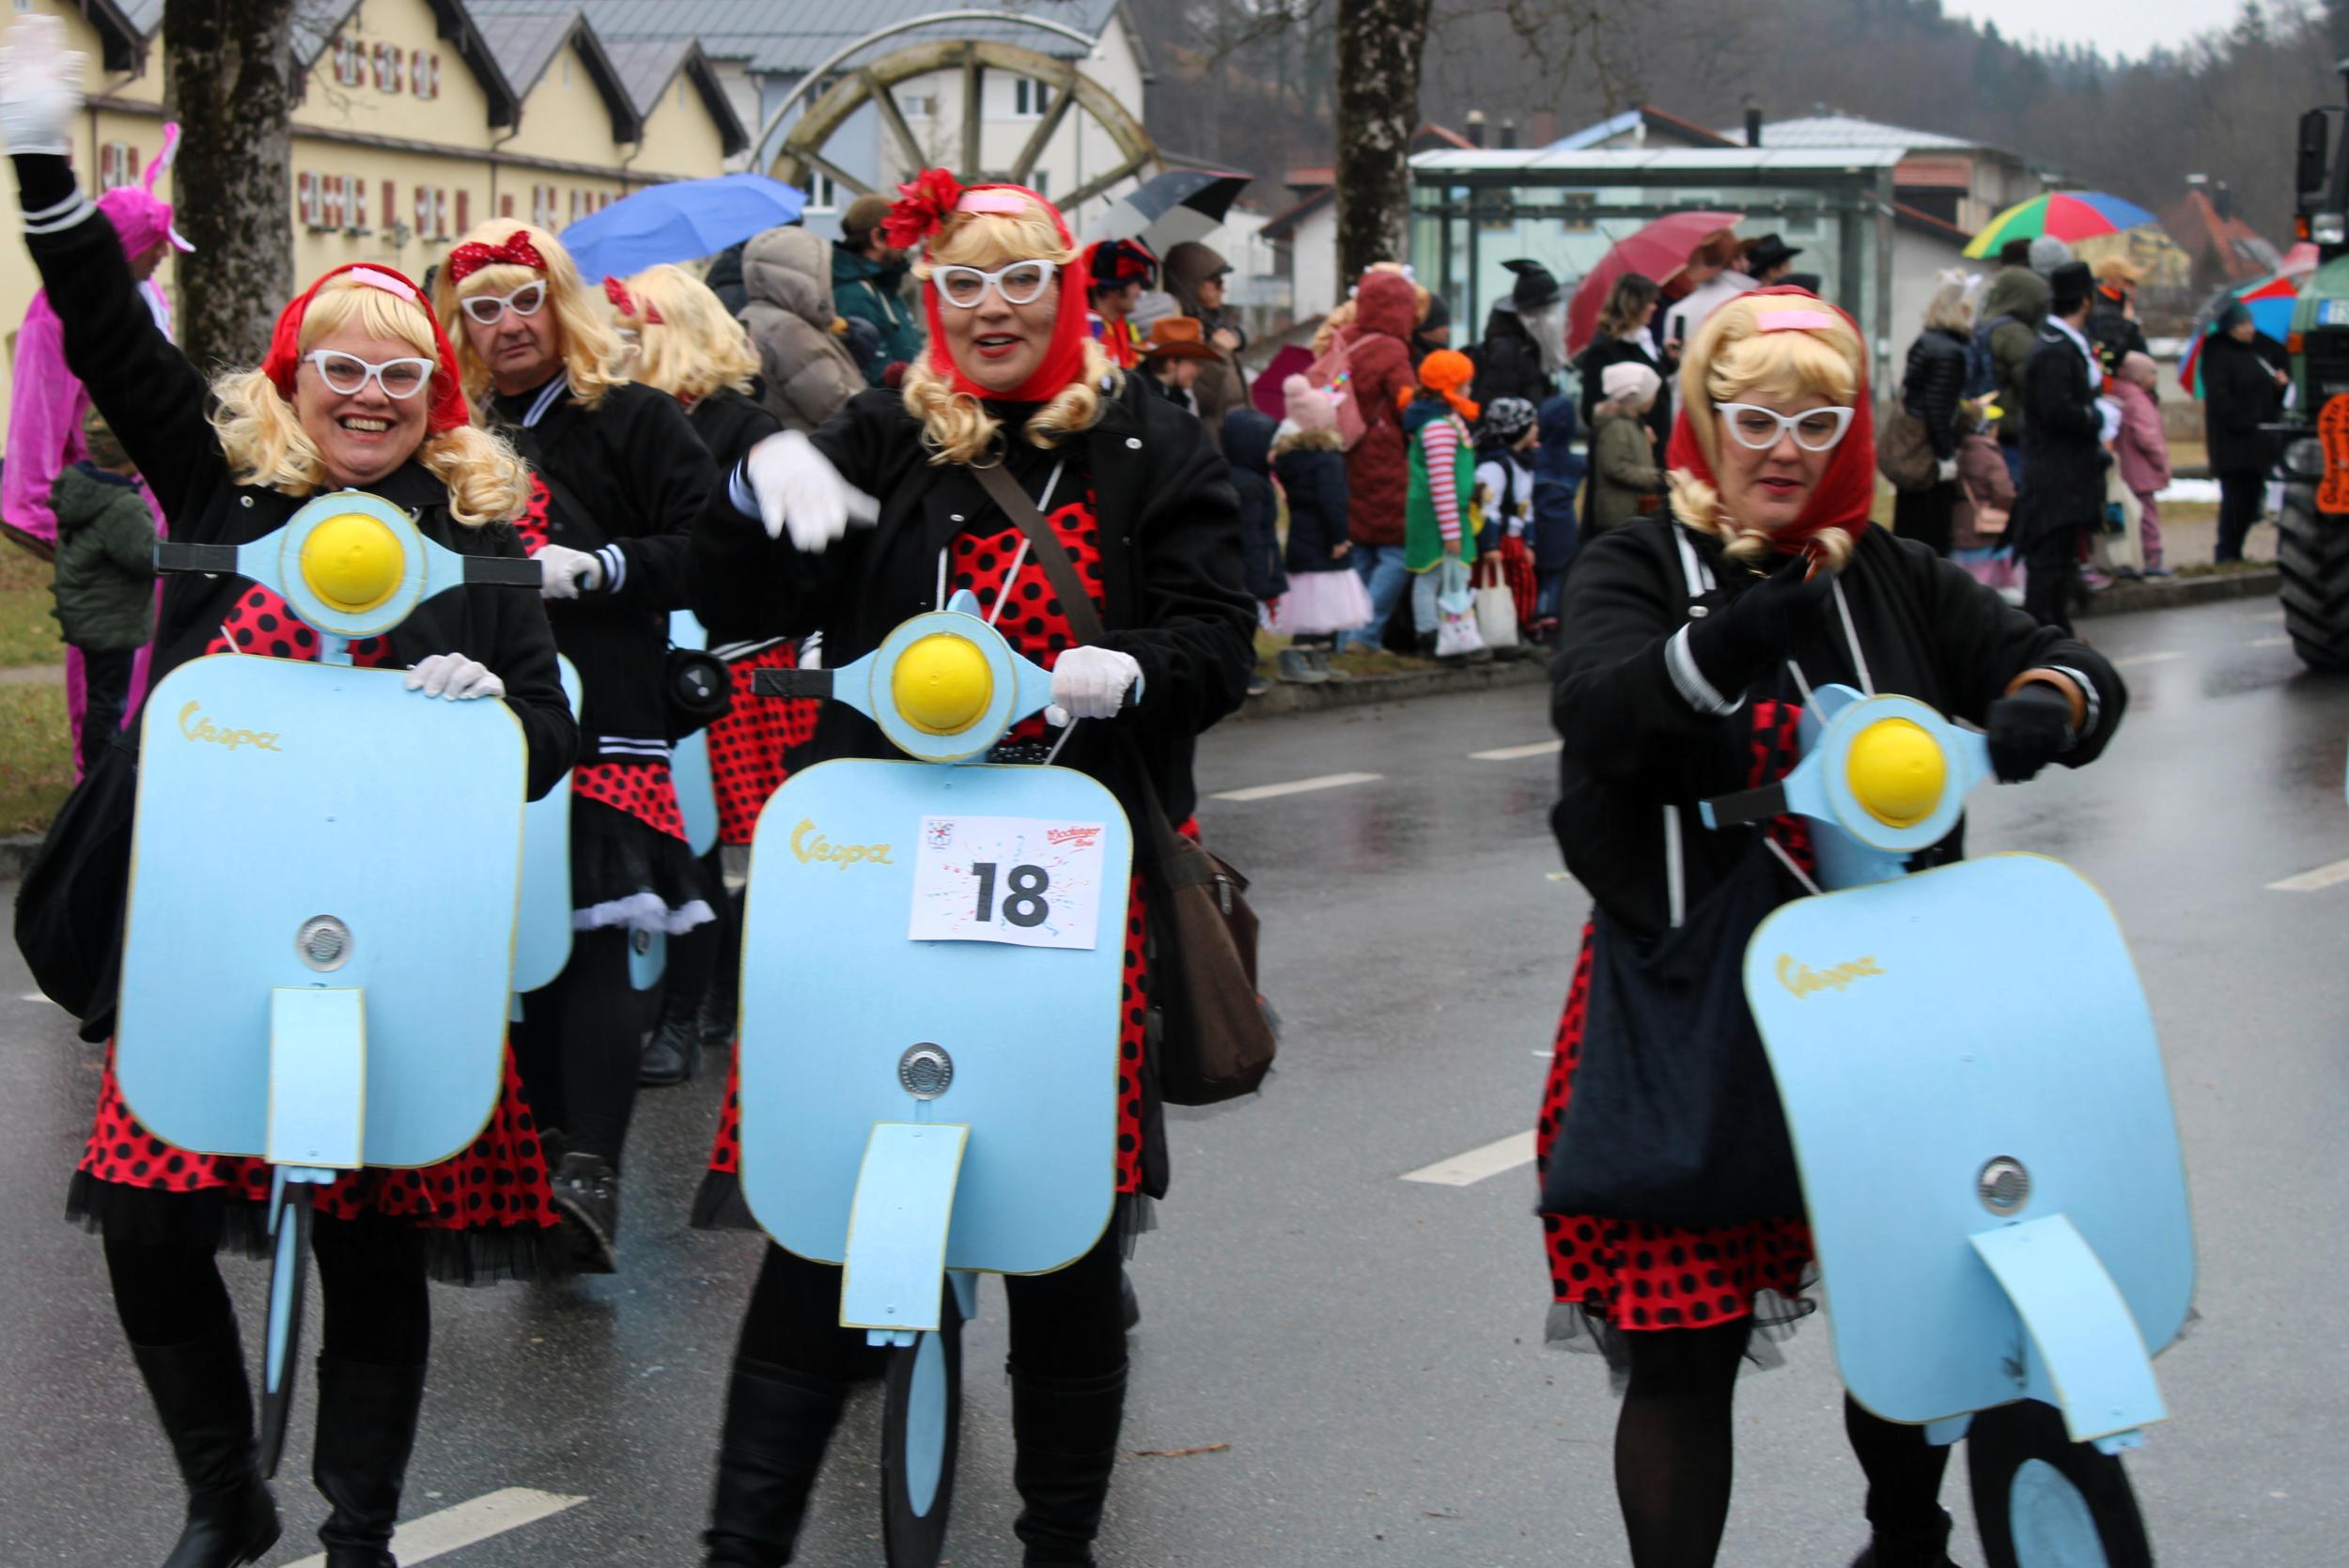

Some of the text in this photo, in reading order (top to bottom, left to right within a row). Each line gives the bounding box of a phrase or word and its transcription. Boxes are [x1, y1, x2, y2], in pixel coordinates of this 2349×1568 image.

[178, 700, 283, 751] Vespa
[790, 817, 894, 871] Vespa
[972, 862, 1050, 927] 18
